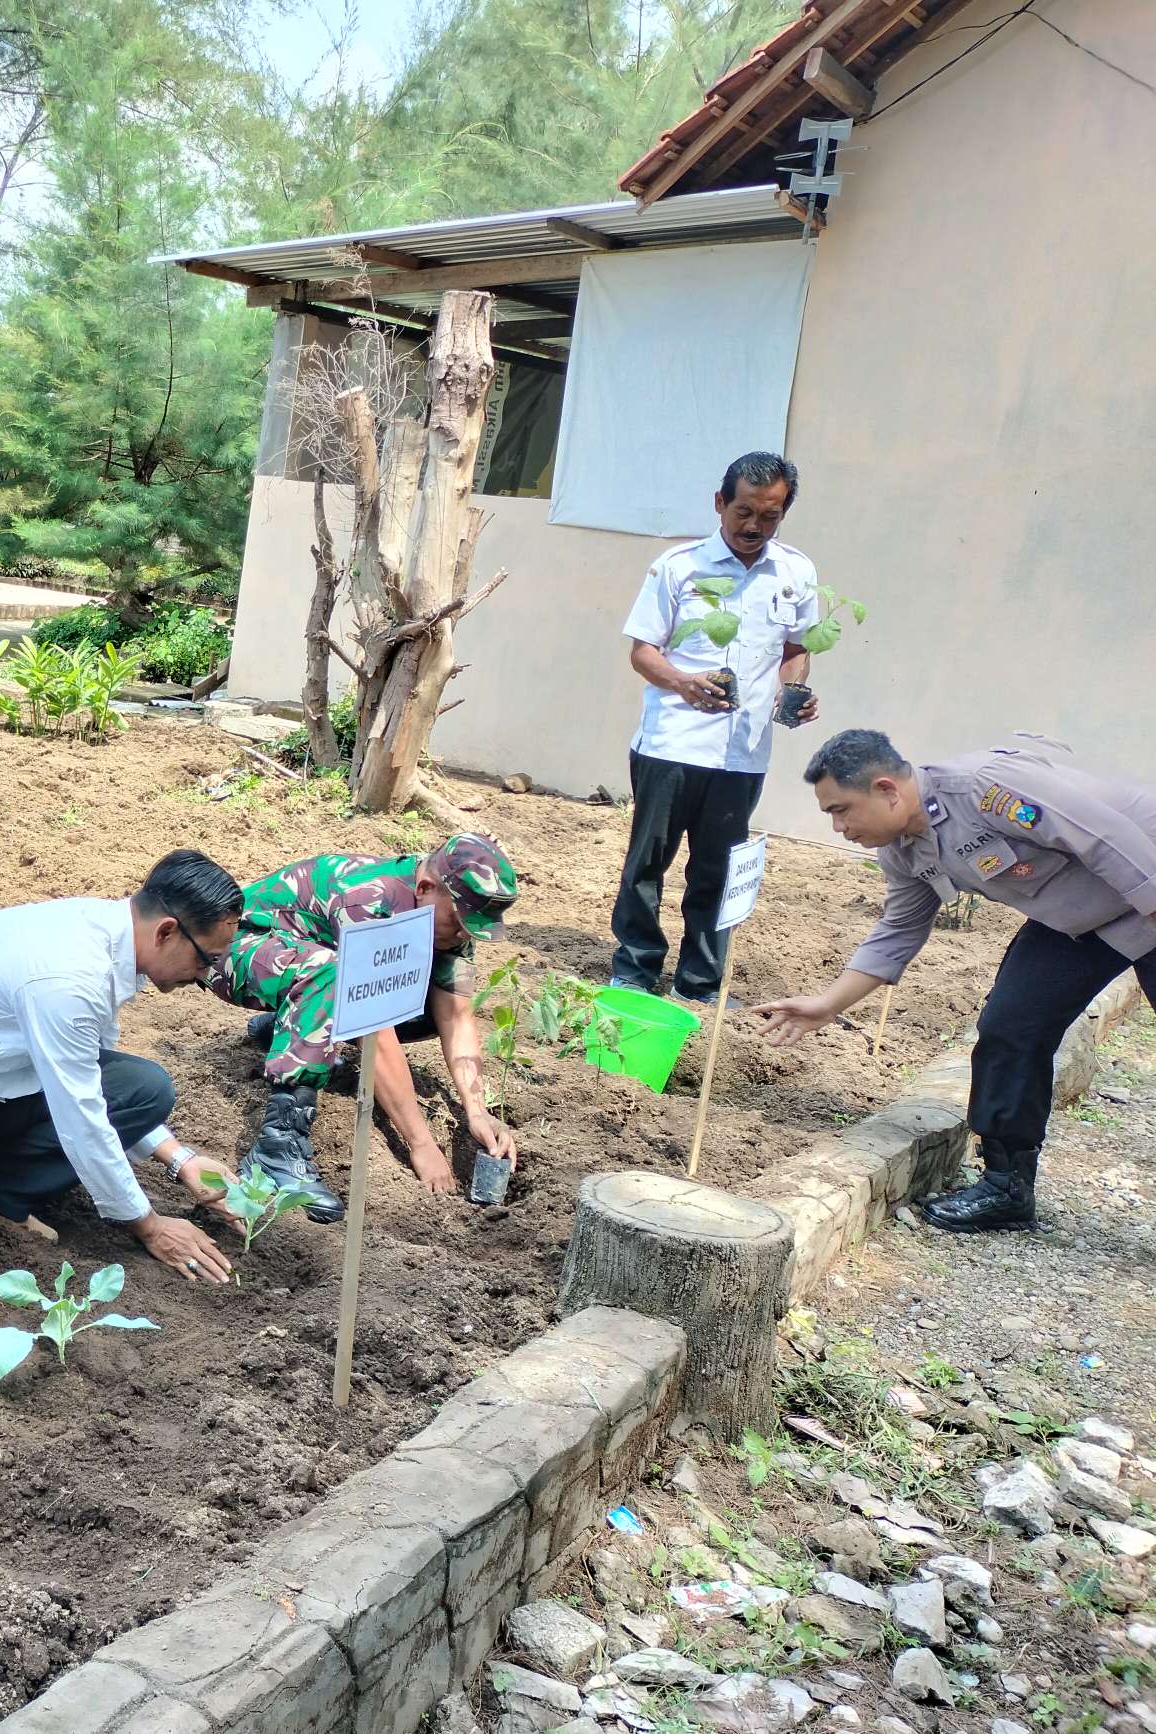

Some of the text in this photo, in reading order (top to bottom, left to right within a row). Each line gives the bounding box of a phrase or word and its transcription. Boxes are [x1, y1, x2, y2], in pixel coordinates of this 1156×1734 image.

[956, 832, 995, 857] POLRI
[915, 864, 940, 881] ENI
[373, 943, 410, 968] CAMAT
[347, 968, 421, 1003] KEDUNGWARU
